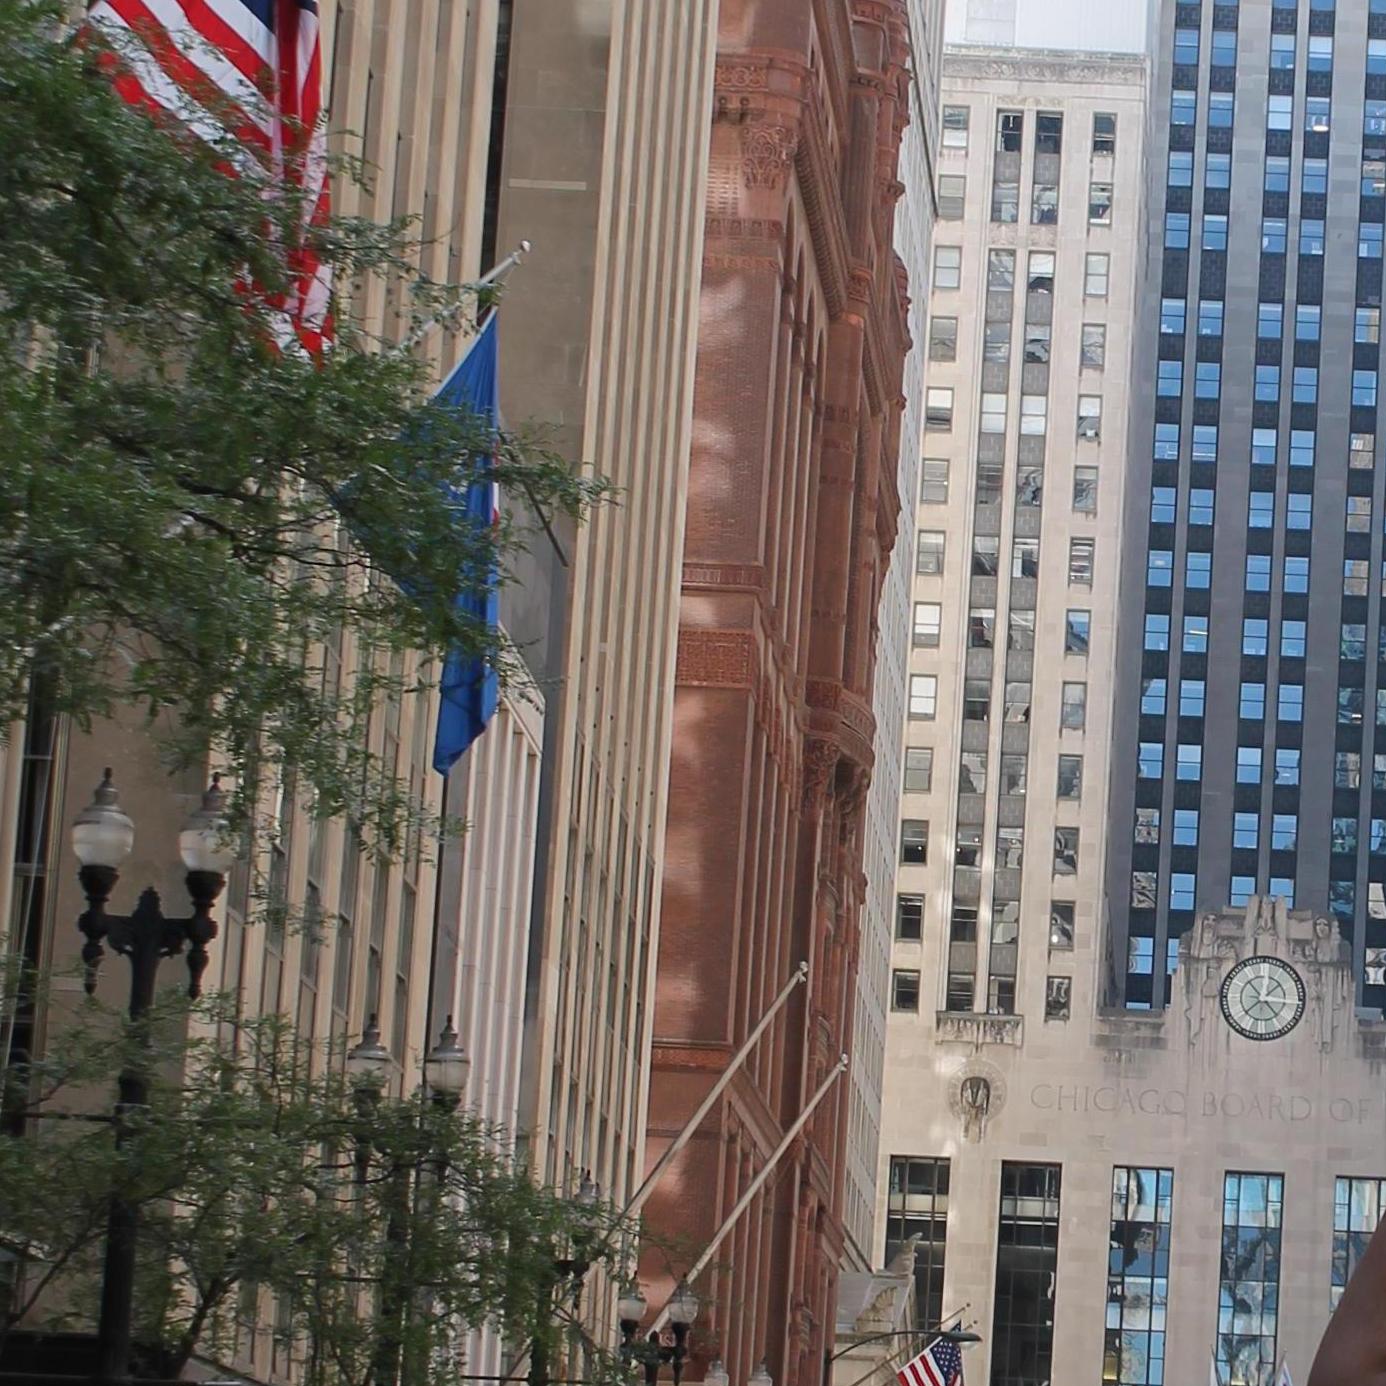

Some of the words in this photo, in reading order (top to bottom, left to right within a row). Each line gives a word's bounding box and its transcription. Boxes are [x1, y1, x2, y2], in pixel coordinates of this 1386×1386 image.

[1031, 1084, 1185, 1115] CHICAGO
[1202, 1091, 1313, 1122] BOARD
[1329, 1098, 1372, 1125] OF
